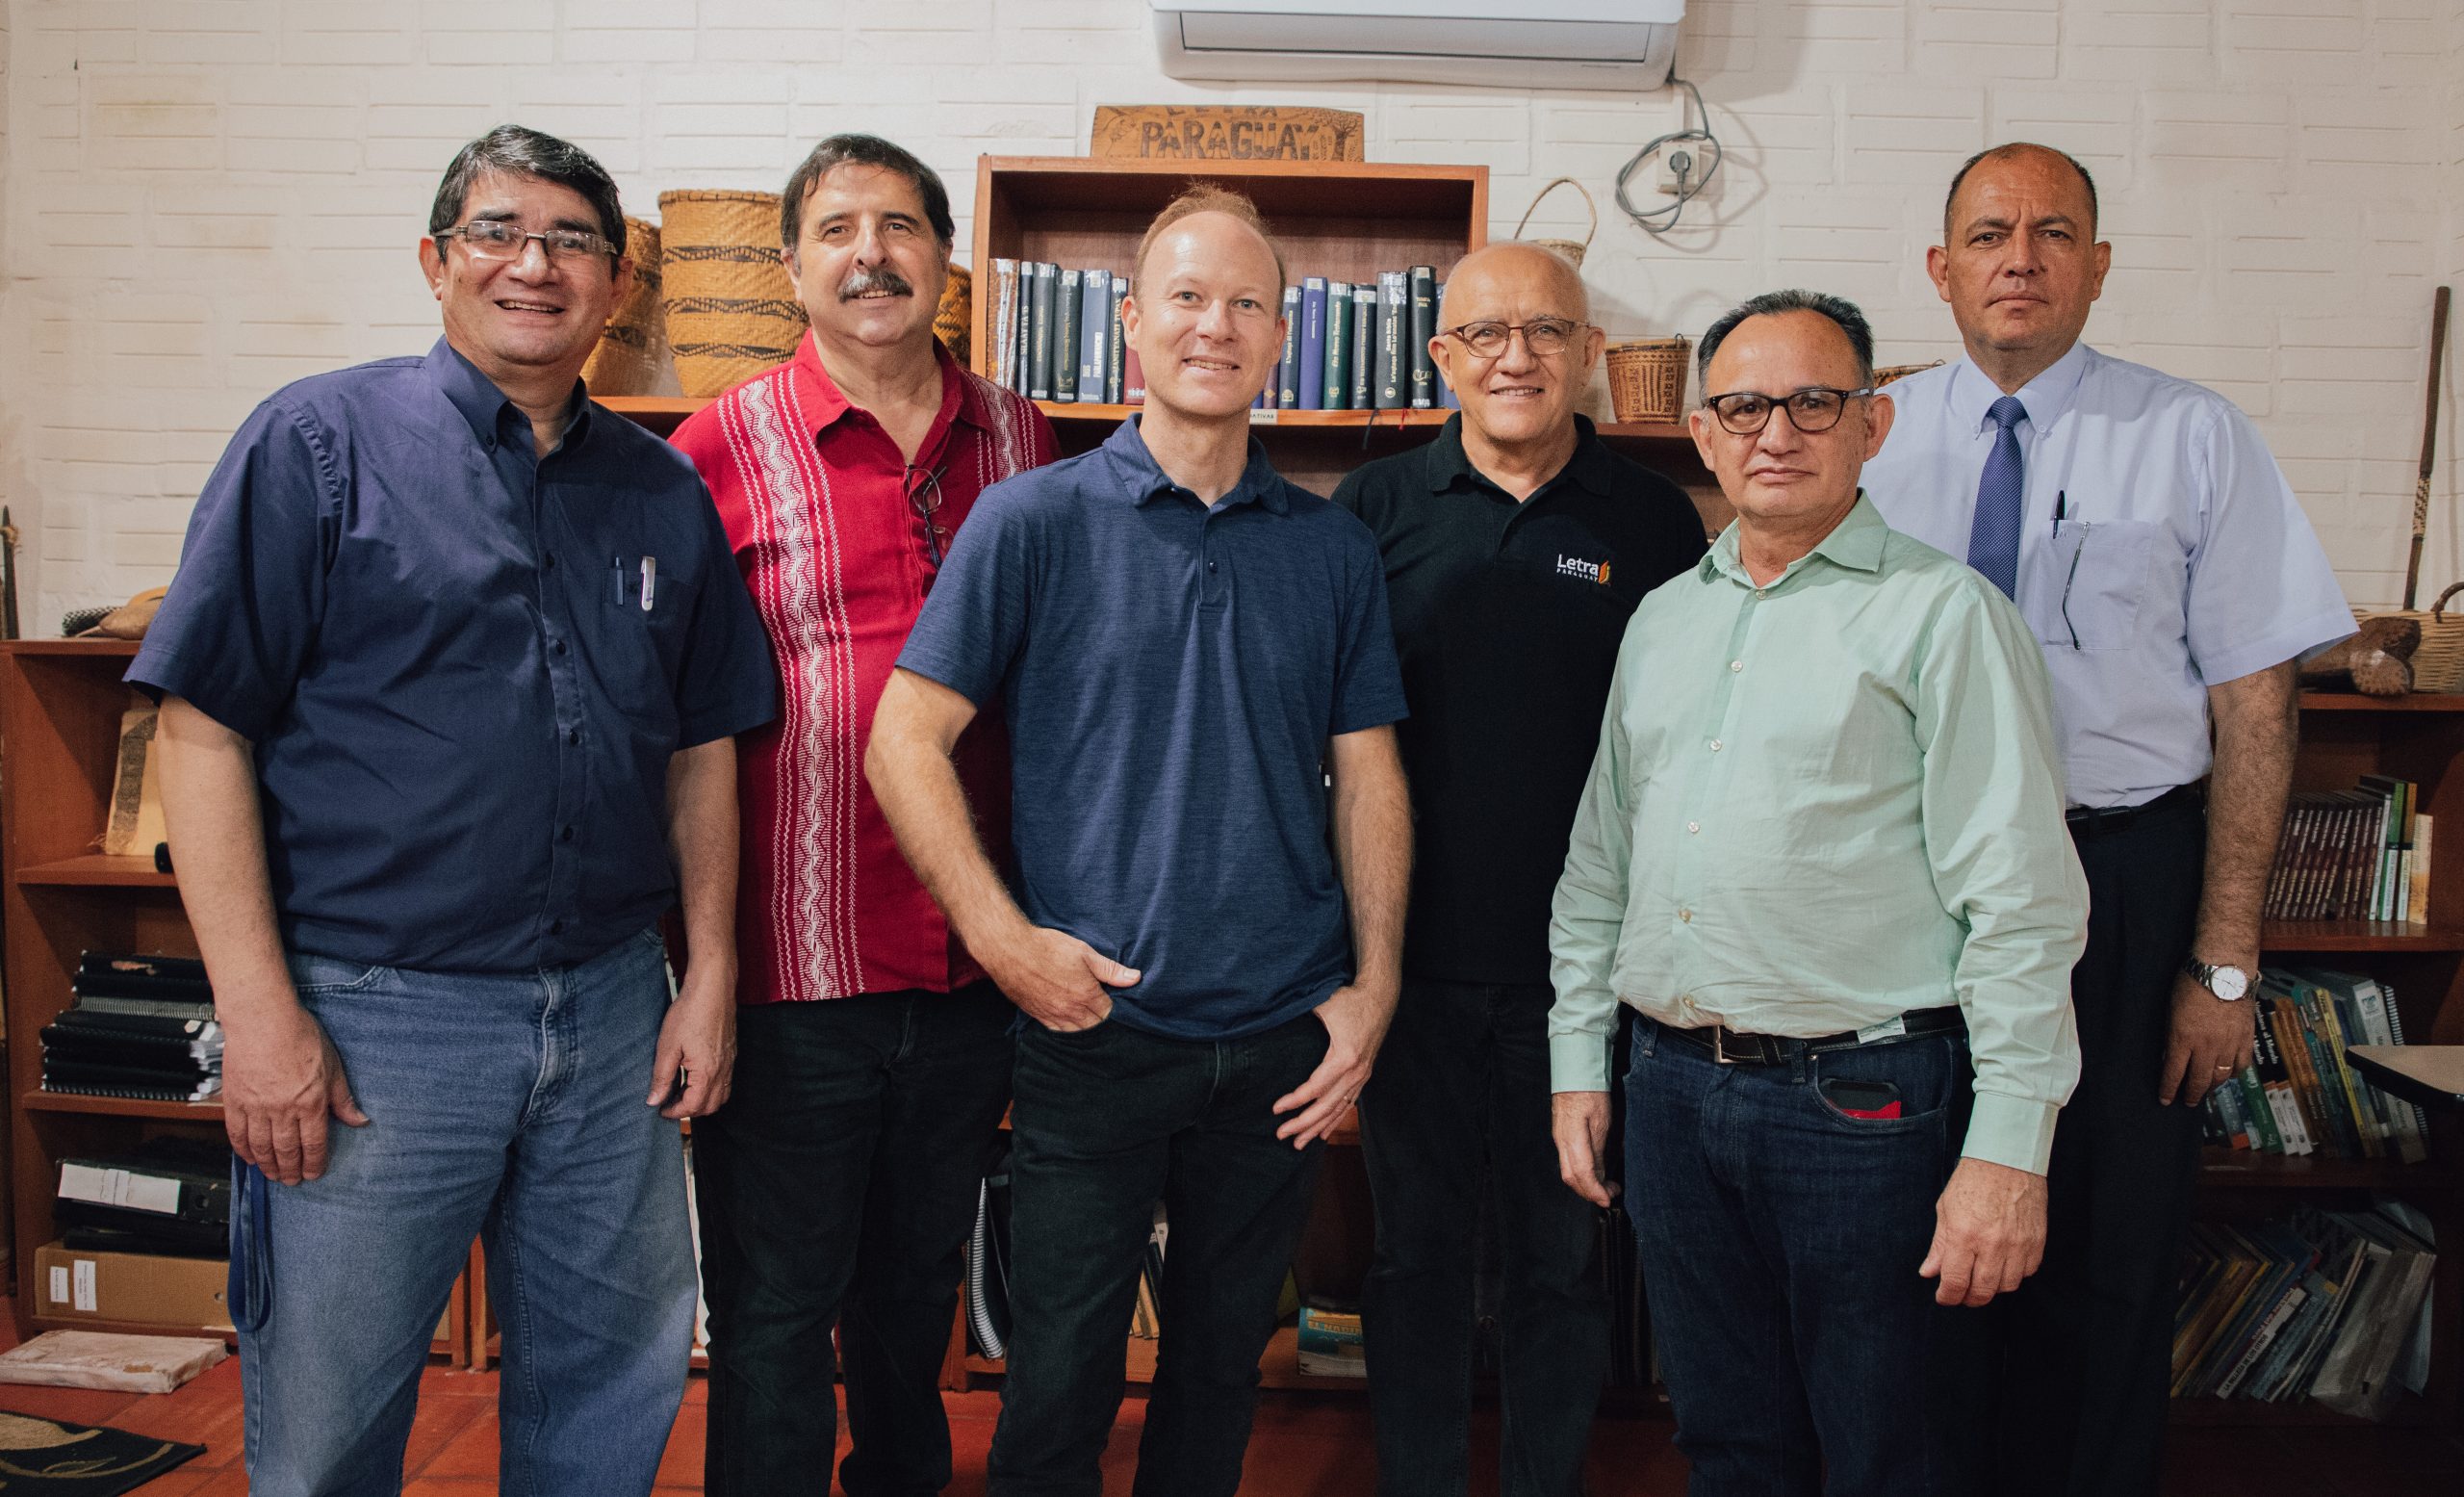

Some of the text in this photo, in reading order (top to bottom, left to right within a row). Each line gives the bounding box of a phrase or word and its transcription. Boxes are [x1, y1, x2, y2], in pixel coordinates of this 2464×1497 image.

[1140, 119, 1321, 161] PARAGUAY
[1556, 567, 1599, 582] PARAGUAY
[1557, 554, 1599, 576] Letra
